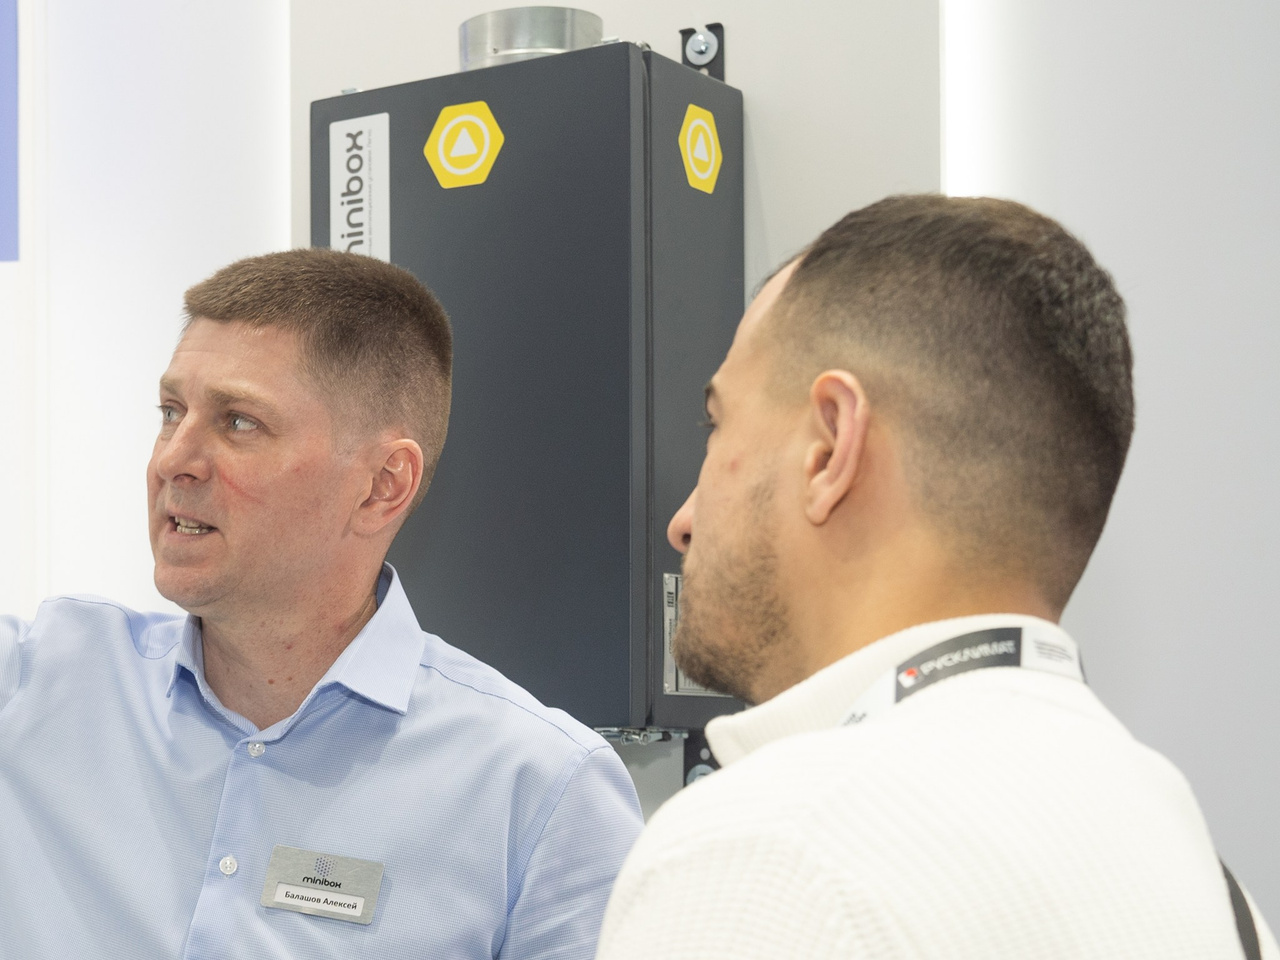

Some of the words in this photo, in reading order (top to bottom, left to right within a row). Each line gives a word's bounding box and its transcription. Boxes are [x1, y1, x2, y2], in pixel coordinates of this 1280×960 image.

[302, 876, 342, 888] minibox
[284, 891, 321, 904] Балашов
[322, 898, 357, 910] Алексей
